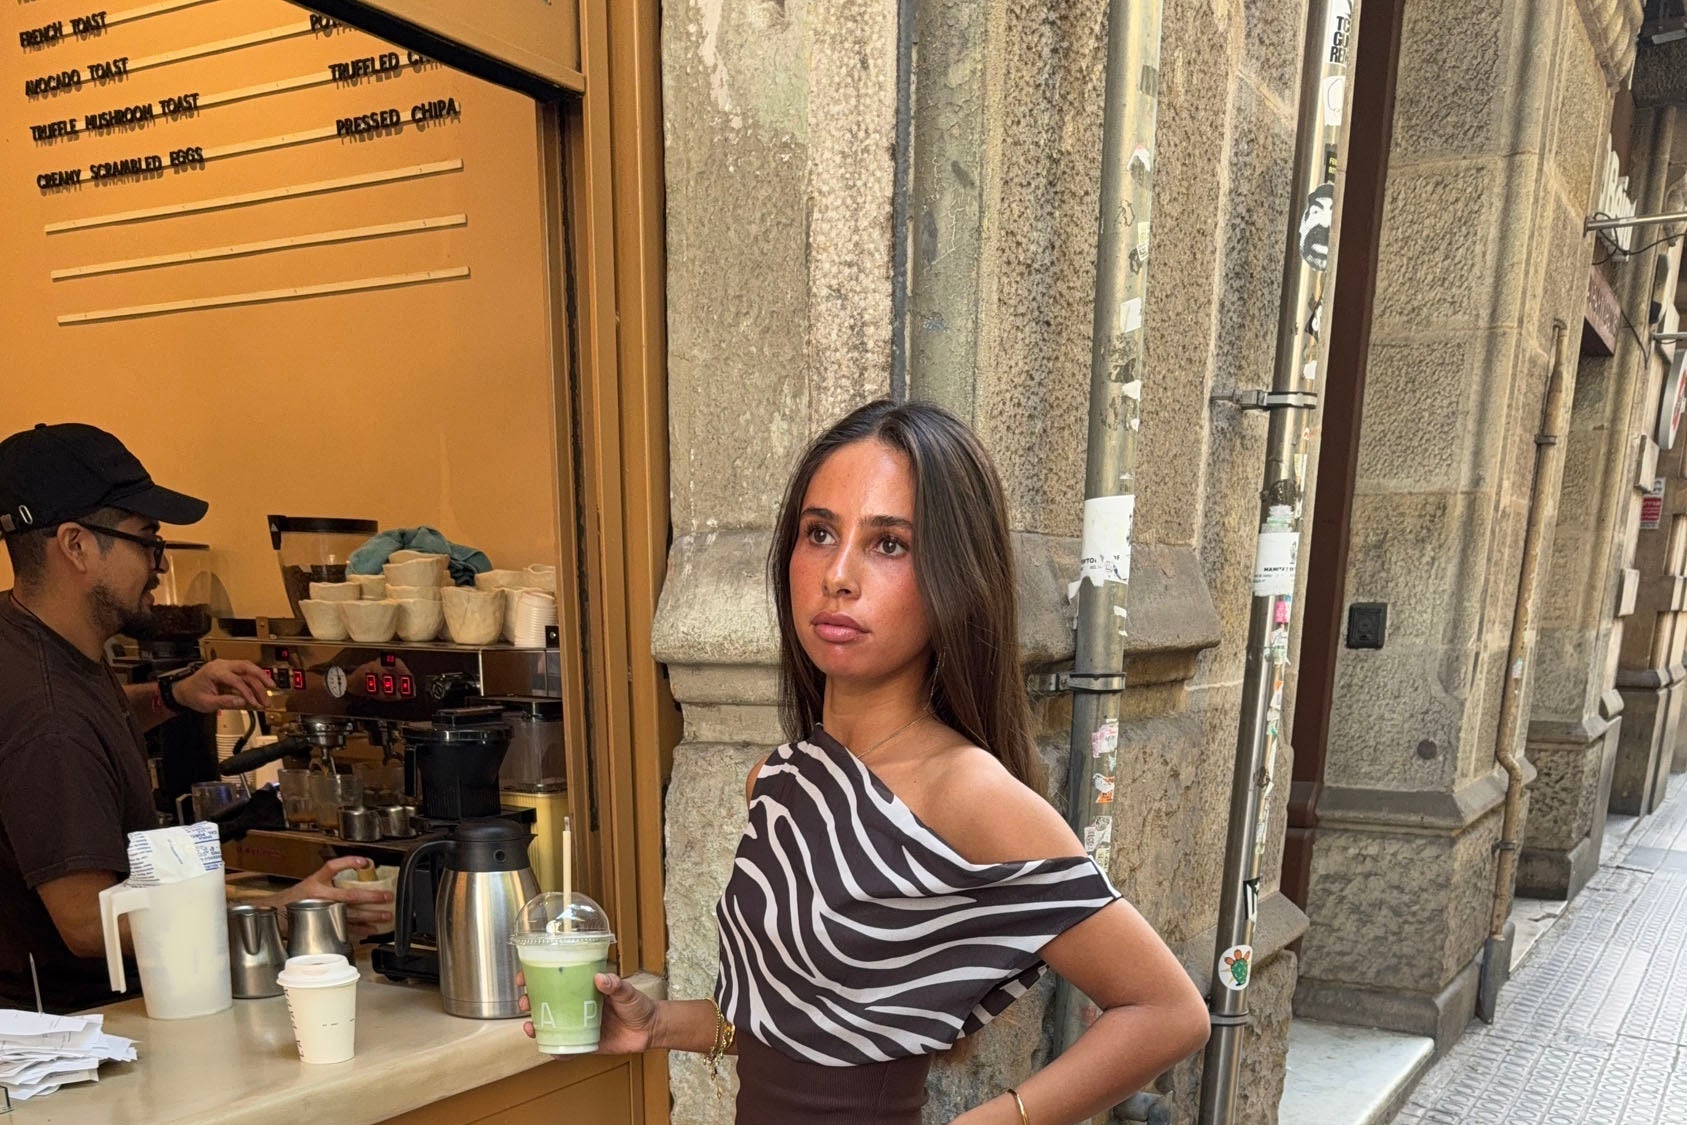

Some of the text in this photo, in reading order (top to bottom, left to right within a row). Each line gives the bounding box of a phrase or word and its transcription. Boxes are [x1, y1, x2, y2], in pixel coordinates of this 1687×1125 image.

[19, 11, 107, 48] FRENCH TOAST
[25, 57, 129, 96] AVOCADO TOAST
[328, 52, 400, 82] TRUFFLED
[30, 92, 200, 142] TRUFFLE MUSHROOM TOAST
[336, 97, 458, 136] PRESSED CHIPA
[36, 146, 205, 190] CREAMY SCRAMBLED EGGS
